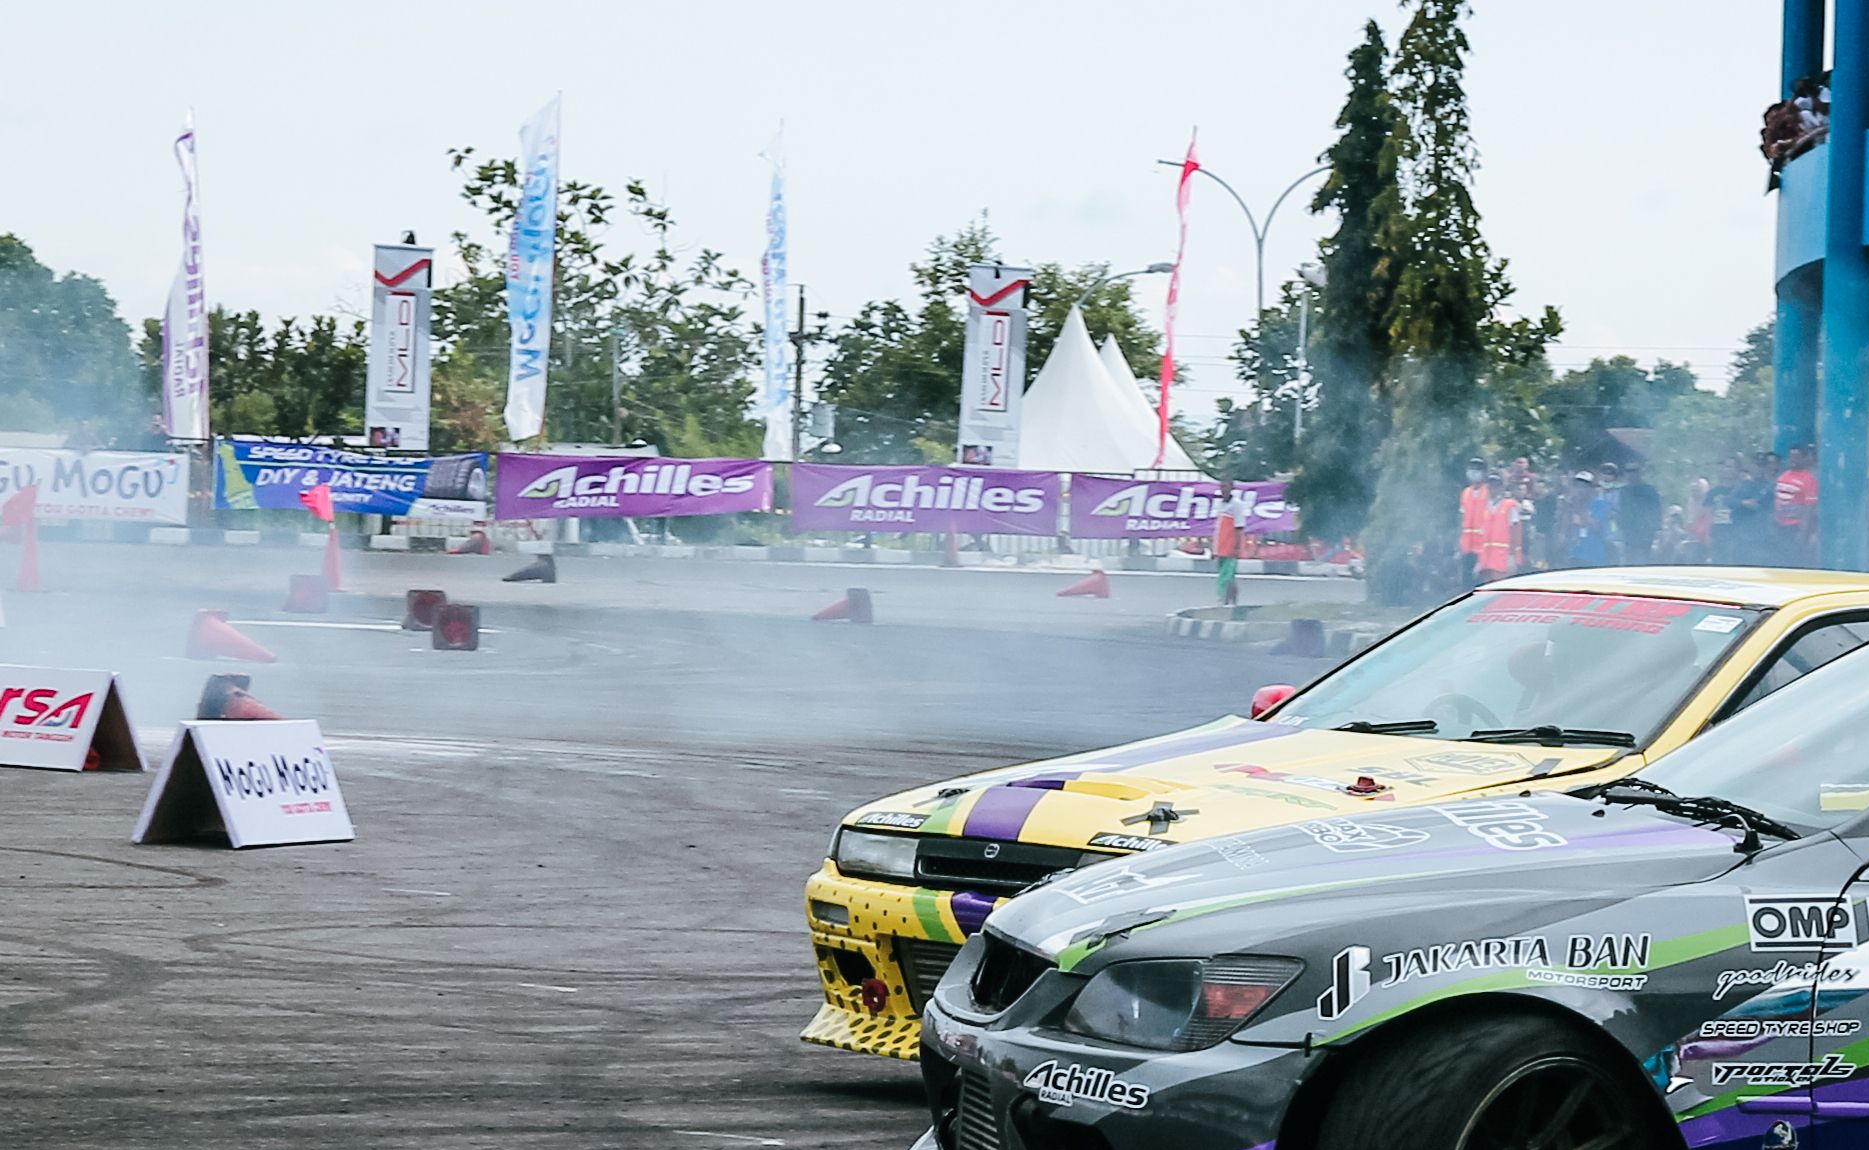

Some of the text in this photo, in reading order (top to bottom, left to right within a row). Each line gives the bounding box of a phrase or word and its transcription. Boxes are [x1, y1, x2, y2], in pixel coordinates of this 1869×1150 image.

[254, 467, 299, 487] DIY
[301, 468, 319, 487] &
[516, 464, 756, 499] Achilles
[813, 473, 1046, 514] Achilles
[849, 509, 917, 524] RADIAL
[1125, 518, 1193, 531] RADIAL
[859, 812, 925, 829] Achilles
[1752, 905, 1850, 939] OMP
[1382, 934, 1650, 987] JAKARTA BAN
[1528, 969, 1648, 990] MOTORSPORT
[1701, 1021, 1861, 1036] SPEED TYRE SHOP
[1024, 1060, 1151, 1109] Achilles
